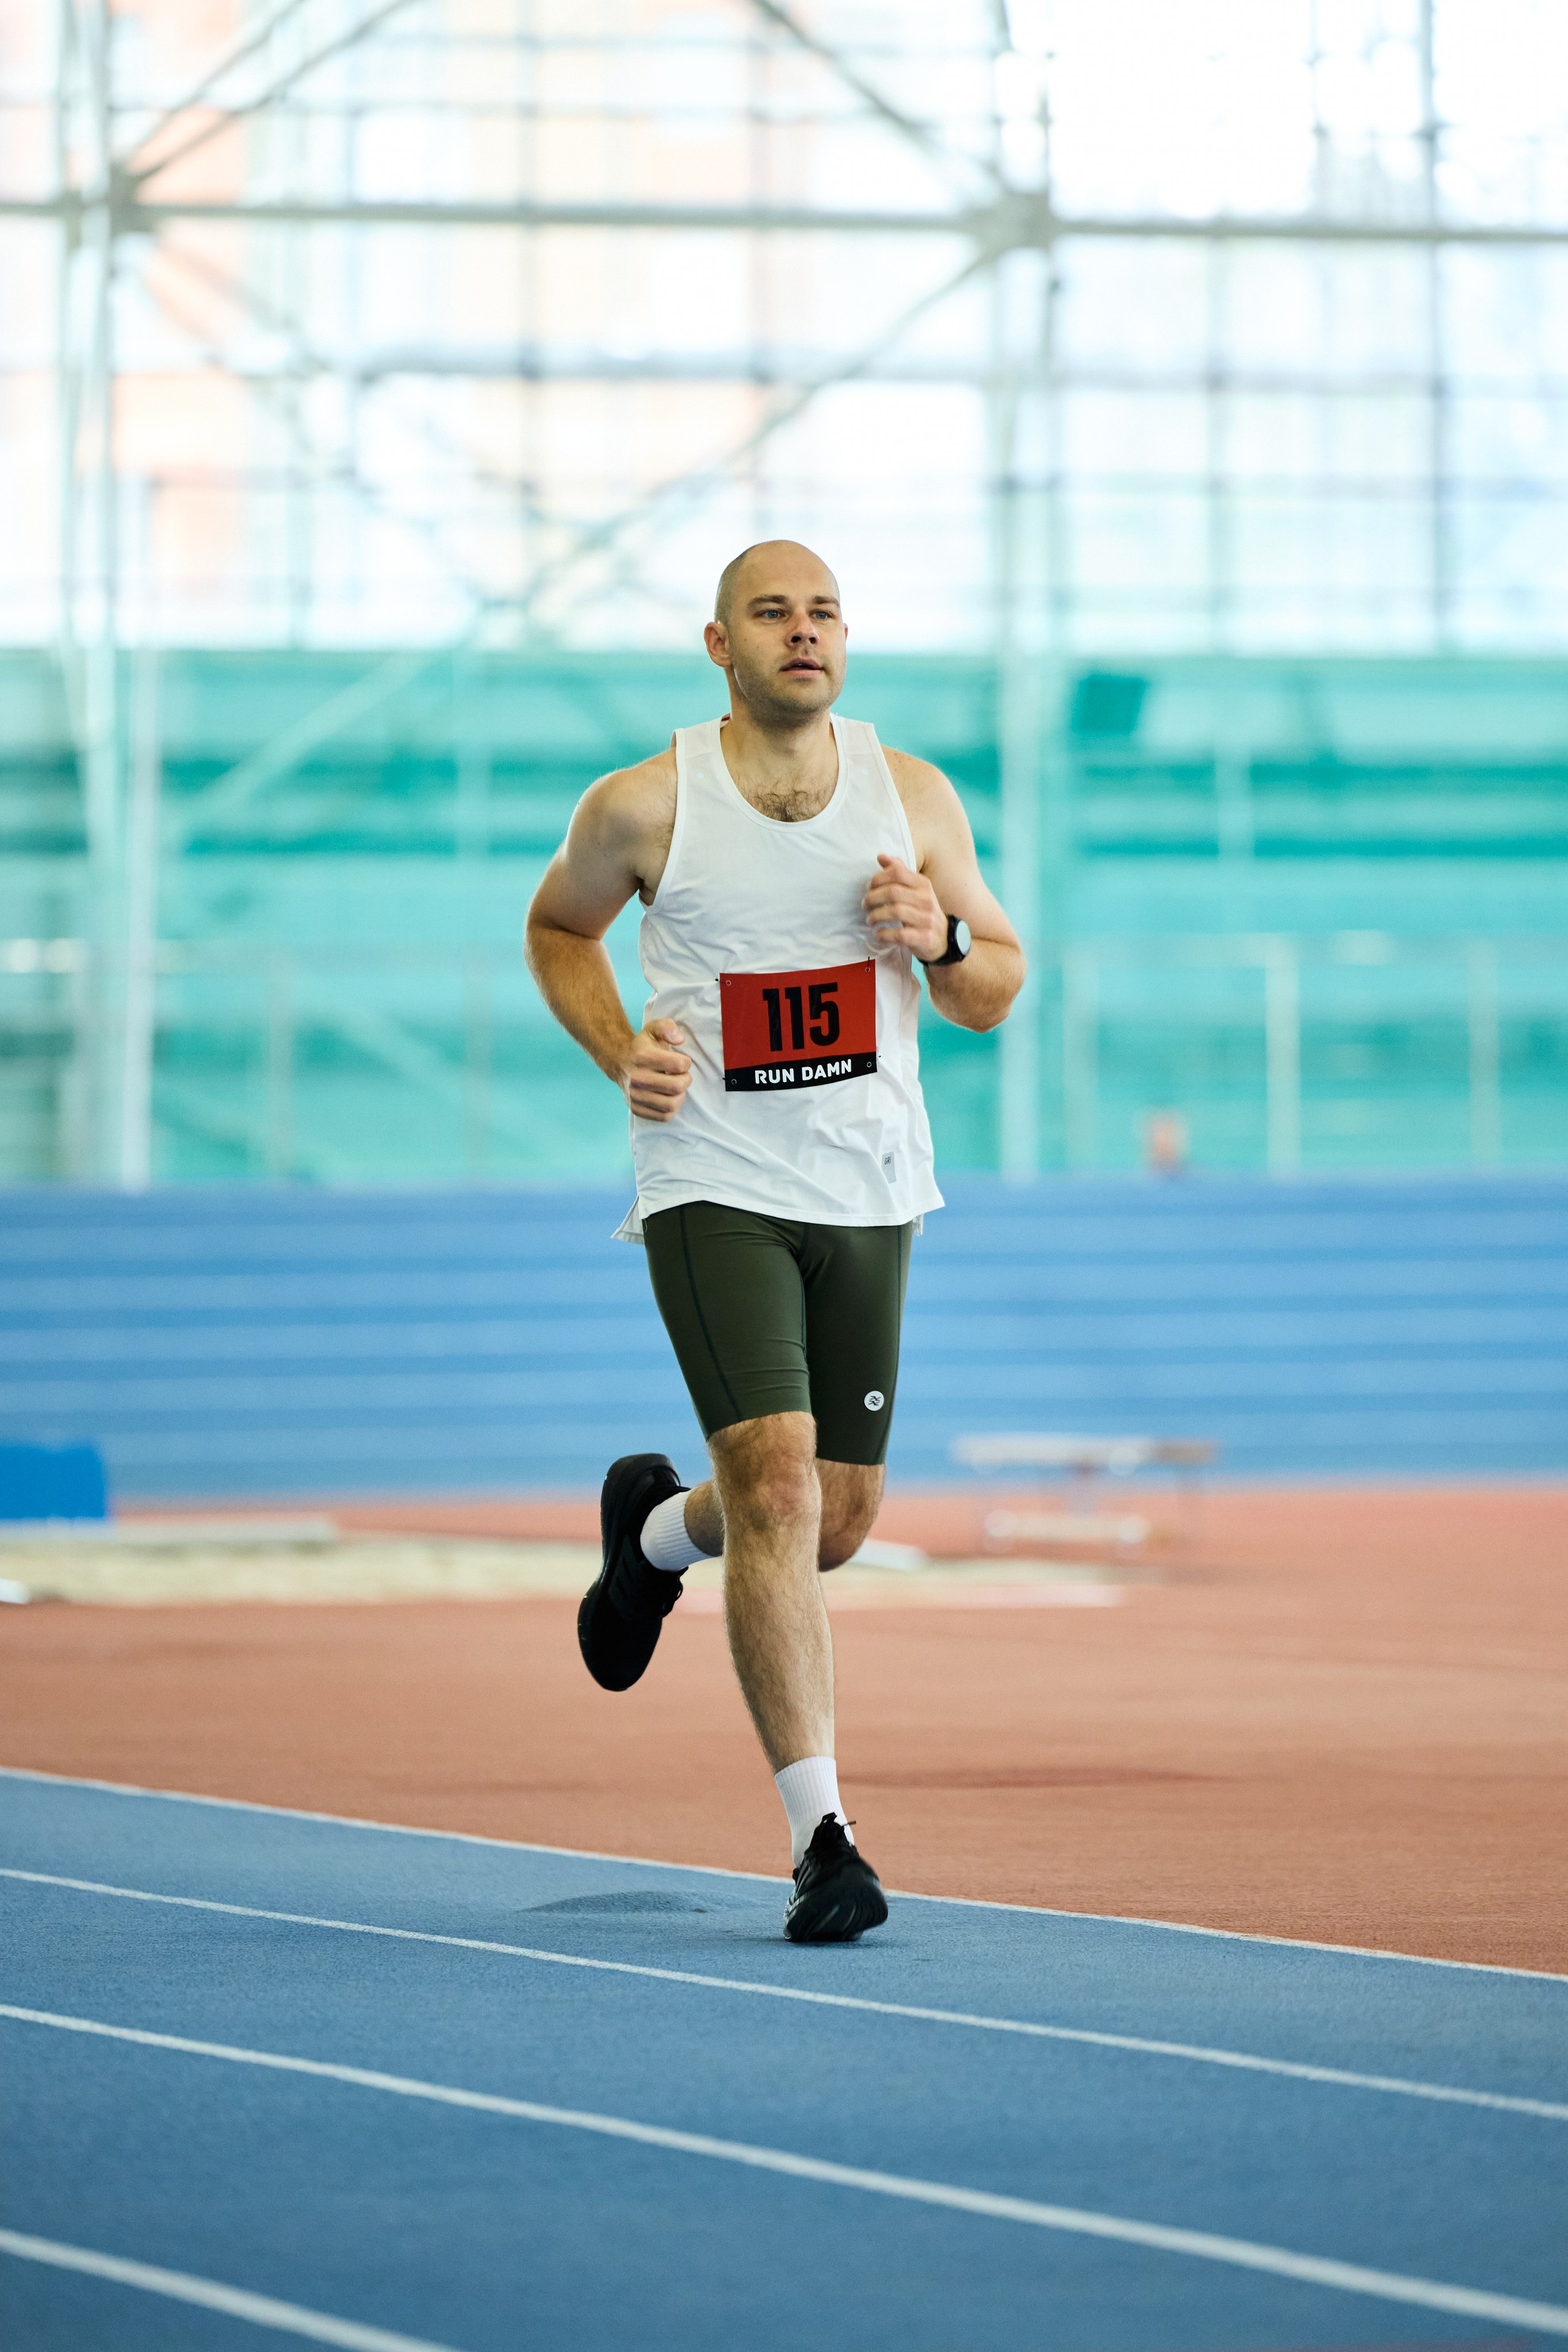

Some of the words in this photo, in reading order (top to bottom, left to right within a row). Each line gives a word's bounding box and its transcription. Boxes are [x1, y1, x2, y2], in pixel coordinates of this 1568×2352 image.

[763, 982, 840, 1052] 115
[755, 1068, 794, 1084] RUN
[802, 1059, 851, 1080] DAMN
